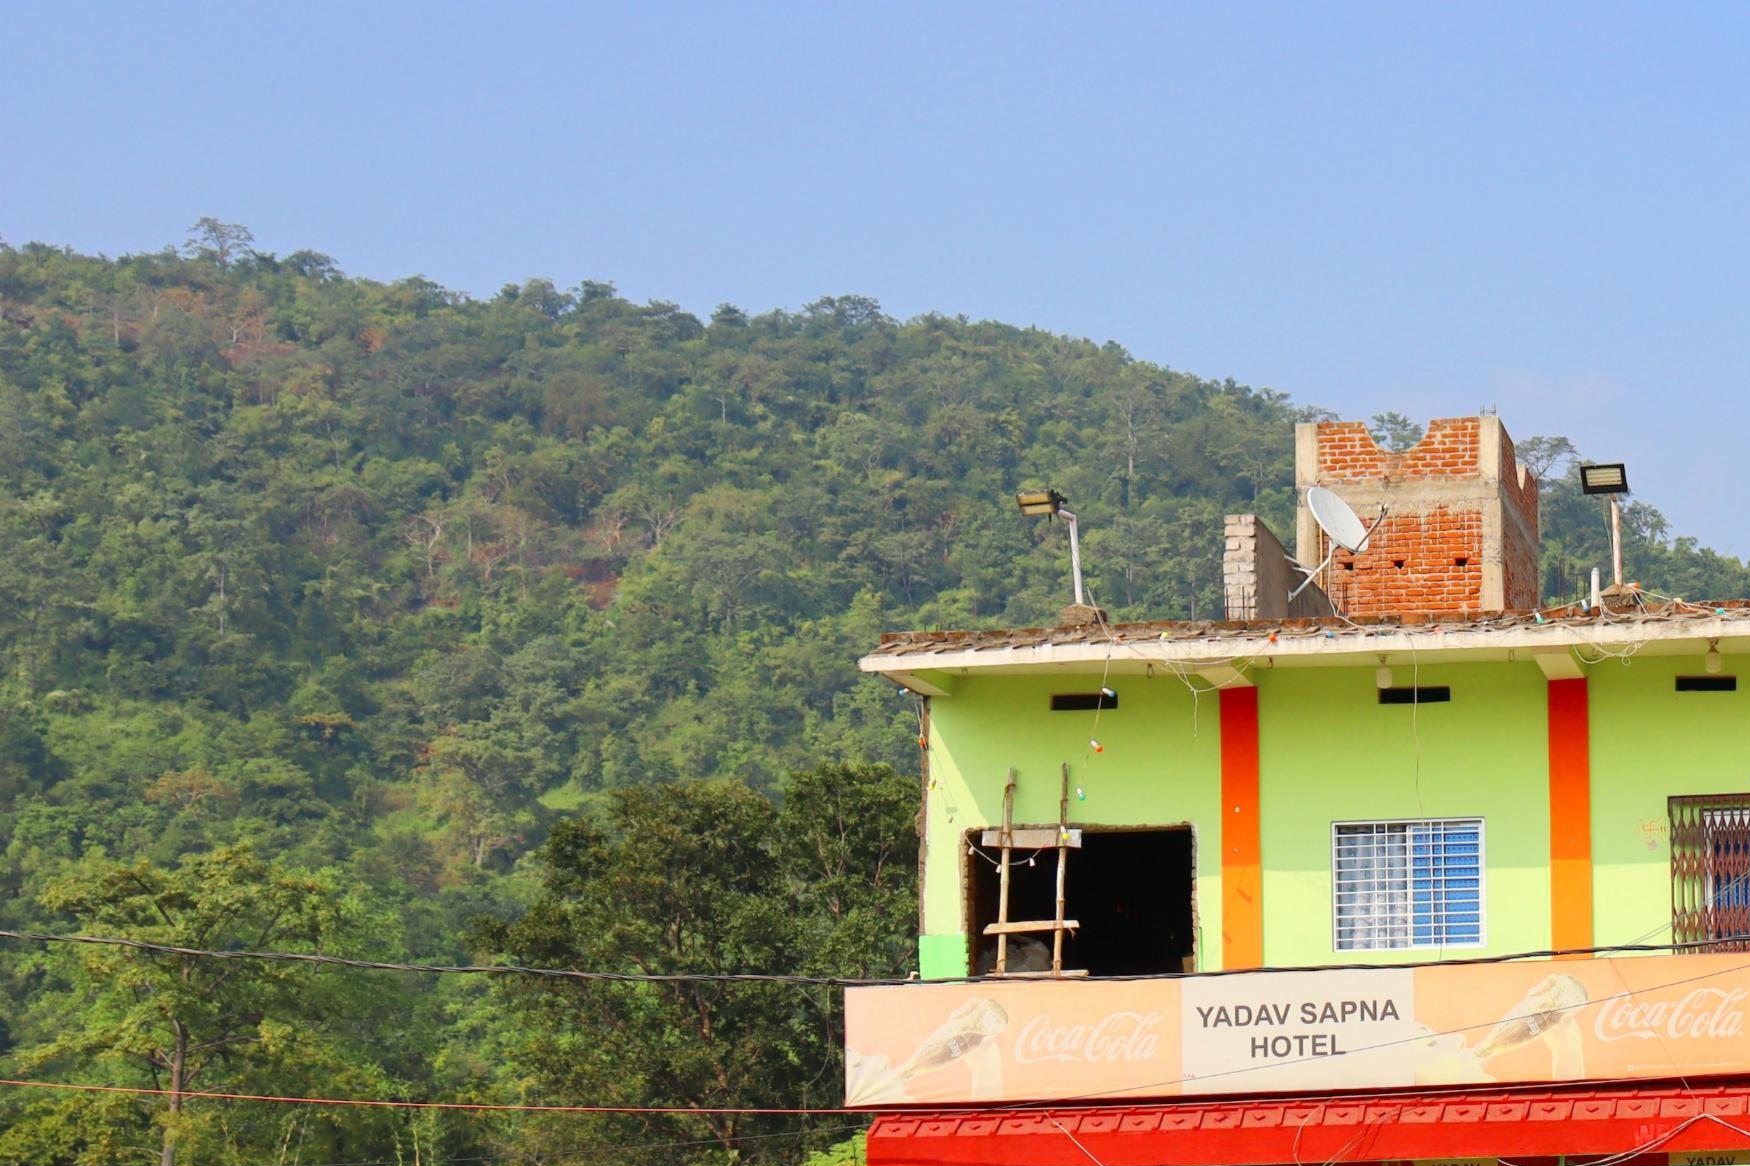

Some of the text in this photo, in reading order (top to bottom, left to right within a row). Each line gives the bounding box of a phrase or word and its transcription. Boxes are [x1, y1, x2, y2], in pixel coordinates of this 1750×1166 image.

[1196, 1000, 1400, 1029] YADAV SAPNA
[1595, 986, 1750, 1043] Coca-Cola
[1015, 1010, 1166, 1064] Coca-Cola
[1250, 1034, 1347, 1059] HOTEL
